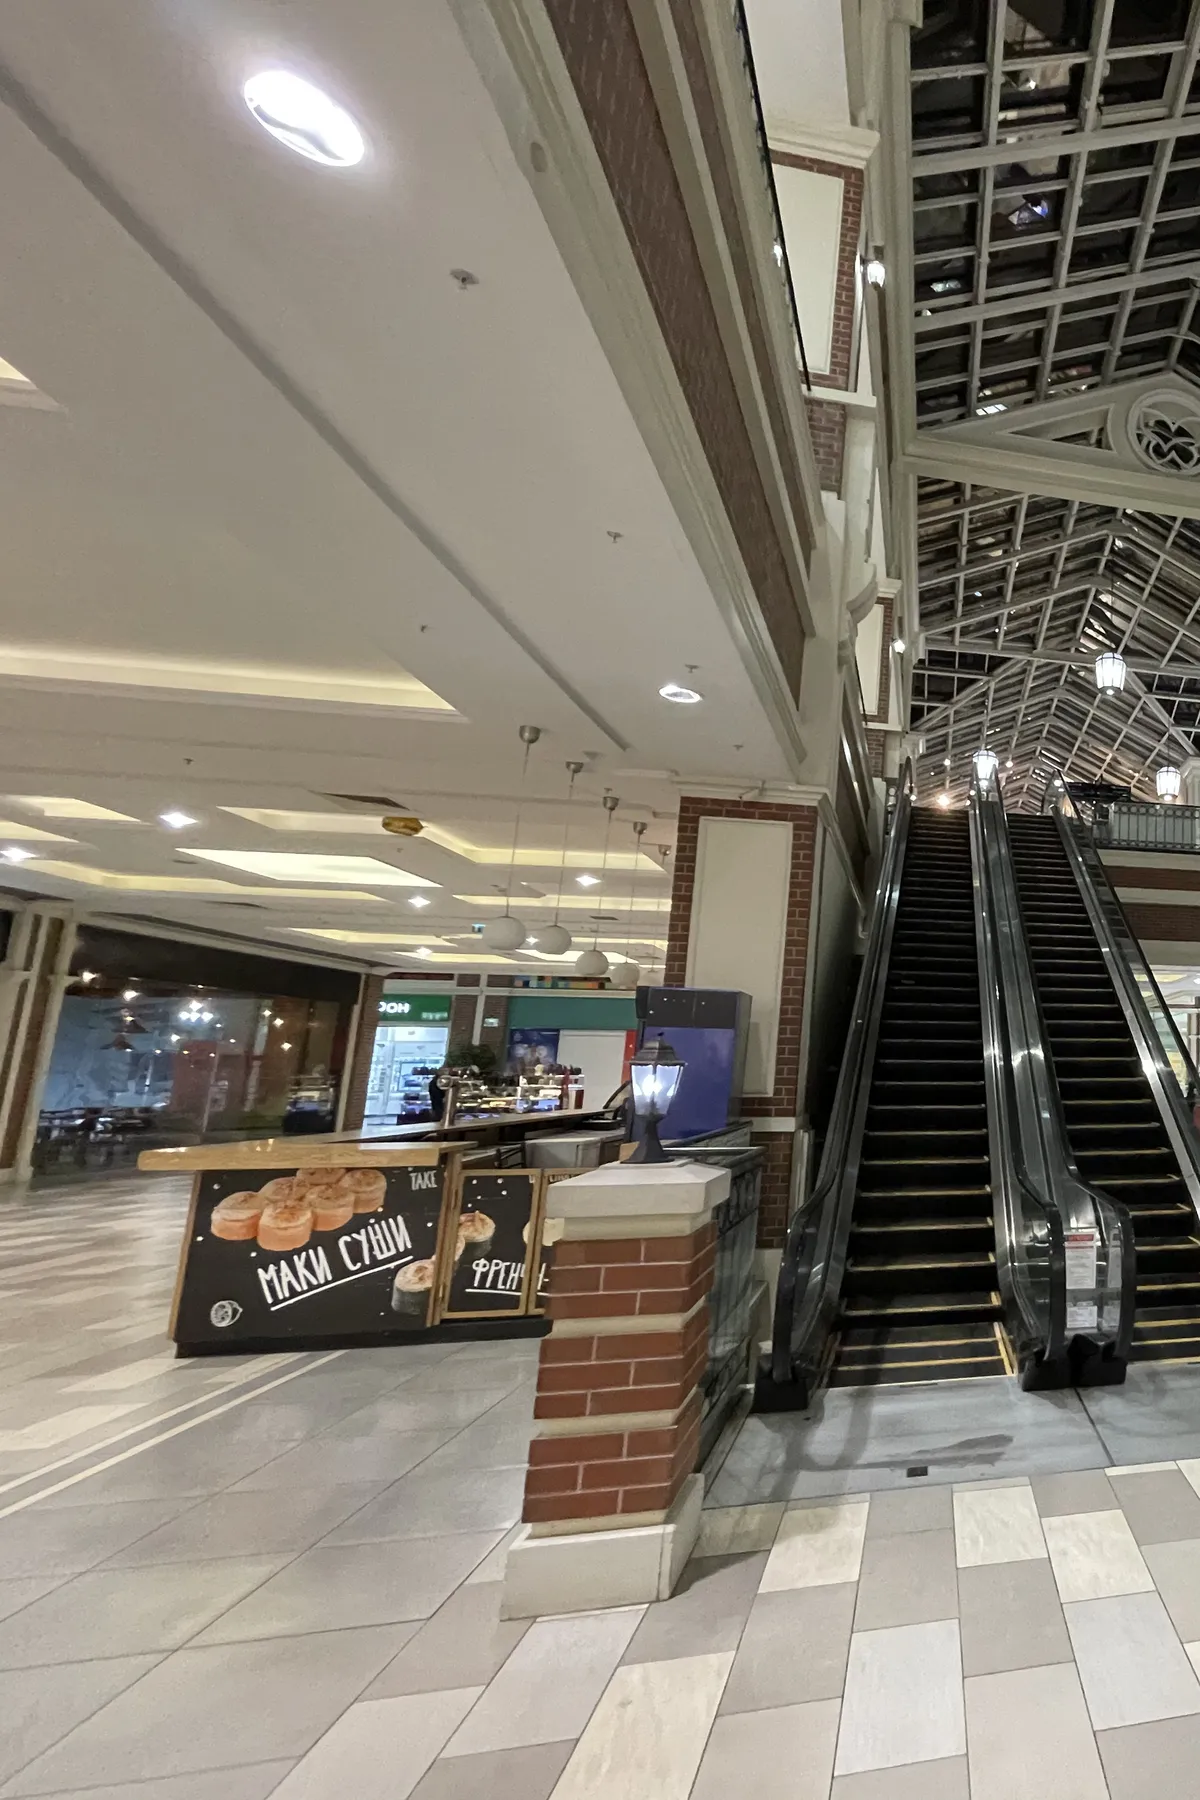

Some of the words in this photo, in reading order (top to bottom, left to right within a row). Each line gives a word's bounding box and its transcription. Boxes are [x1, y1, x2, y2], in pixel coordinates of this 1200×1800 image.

[410, 1170, 438, 1191] TAKE
[257, 1246, 333, 1304] МАКИ
[338, 1214, 412, 1271] СУШИ
